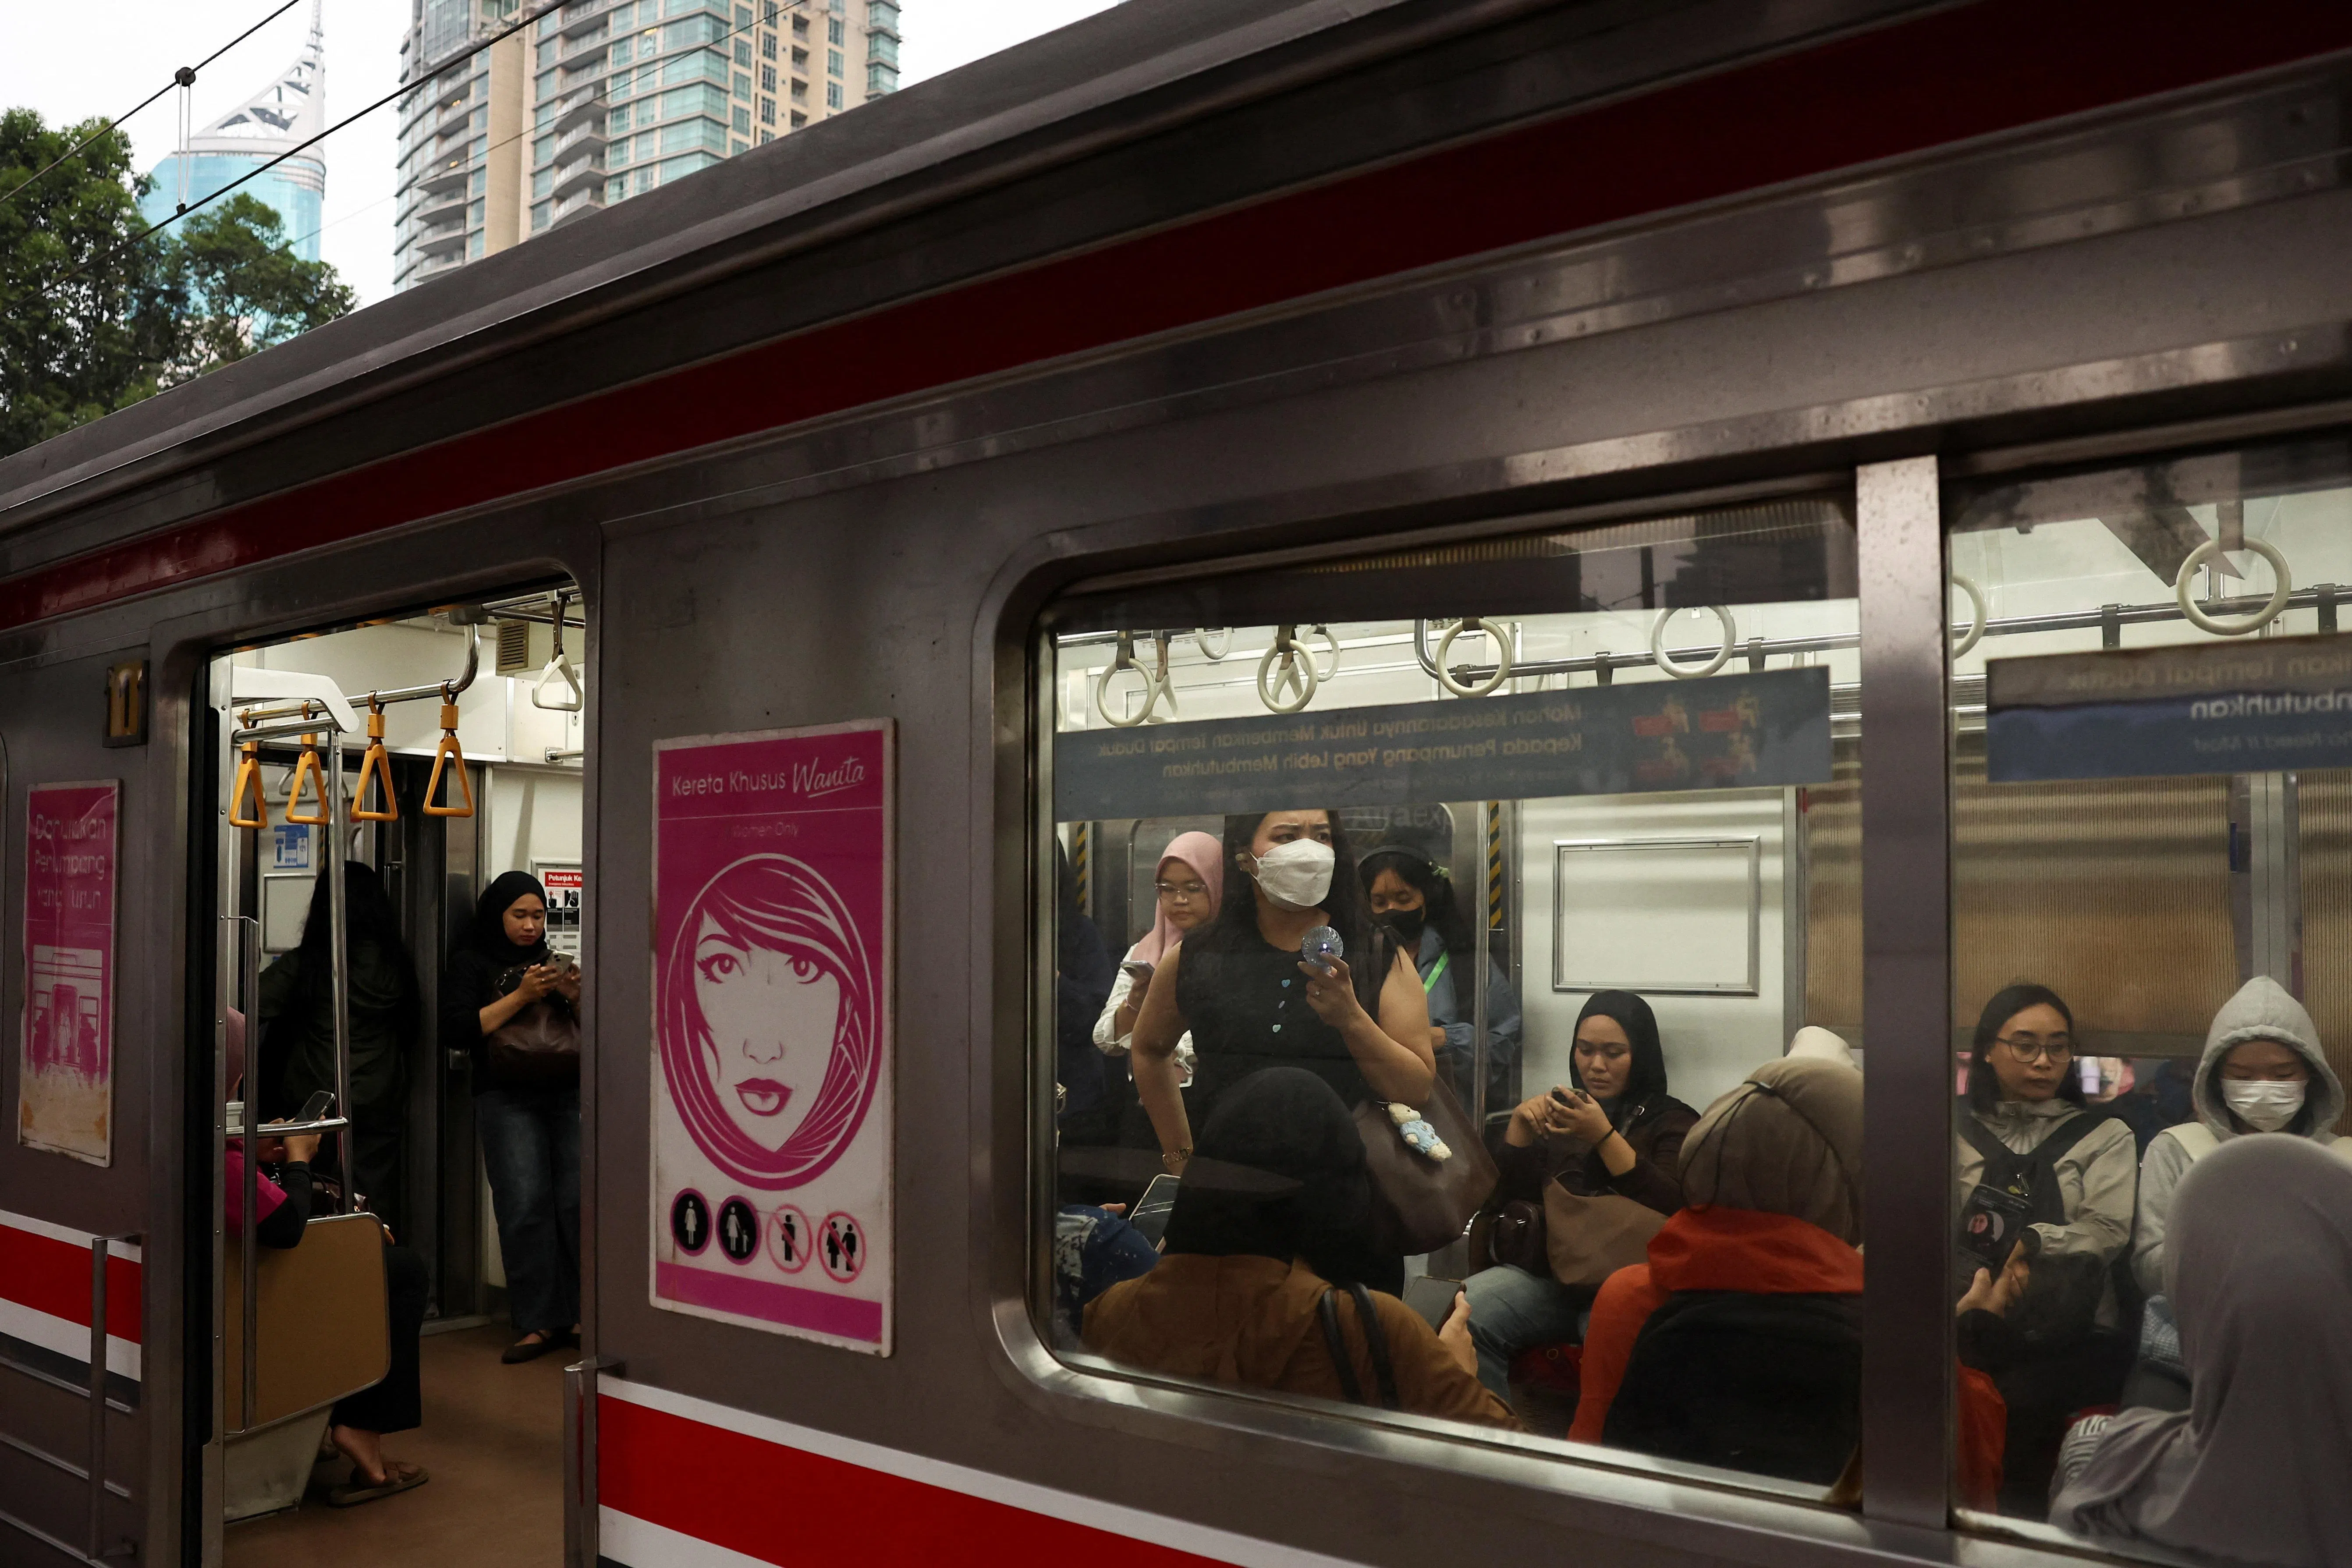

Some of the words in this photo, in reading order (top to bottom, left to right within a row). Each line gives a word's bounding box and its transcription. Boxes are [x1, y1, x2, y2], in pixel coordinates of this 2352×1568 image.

[672, 774, 723, 796] Kereta
[730, 770, 786, 792] Khusus
[792, 756, 865, 794] Wanita
